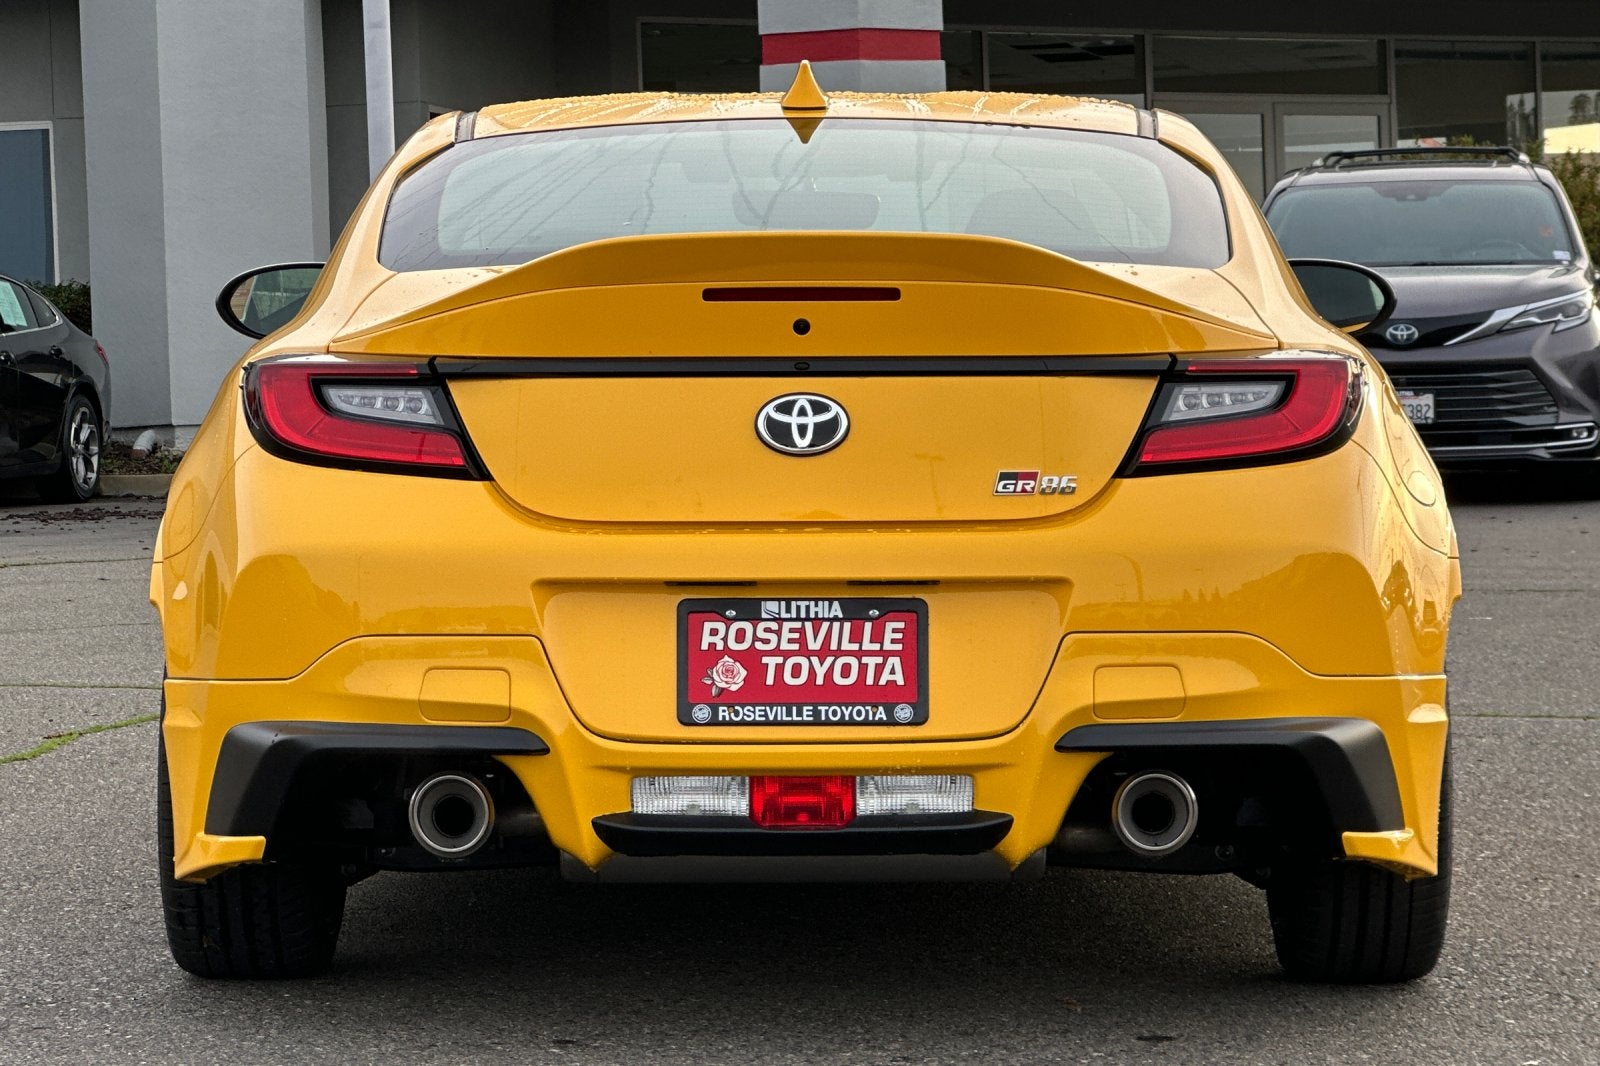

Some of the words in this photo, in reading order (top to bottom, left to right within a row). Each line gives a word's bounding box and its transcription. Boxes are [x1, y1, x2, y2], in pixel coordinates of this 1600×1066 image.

[1401, 403, 1431, 419] 382
[997, 480, 1036, 492] GR
[1040, 475, 1077, 494] 86
[780, 600, 843, 618] LITHIA
[701, 621, 905, 650] ROSEVILLE
[762, 656, 905, 686] TOYOTA
[719, 706, 813, 721] ROSEVILLE
[818, 706, 887, 721] TOYOTA
